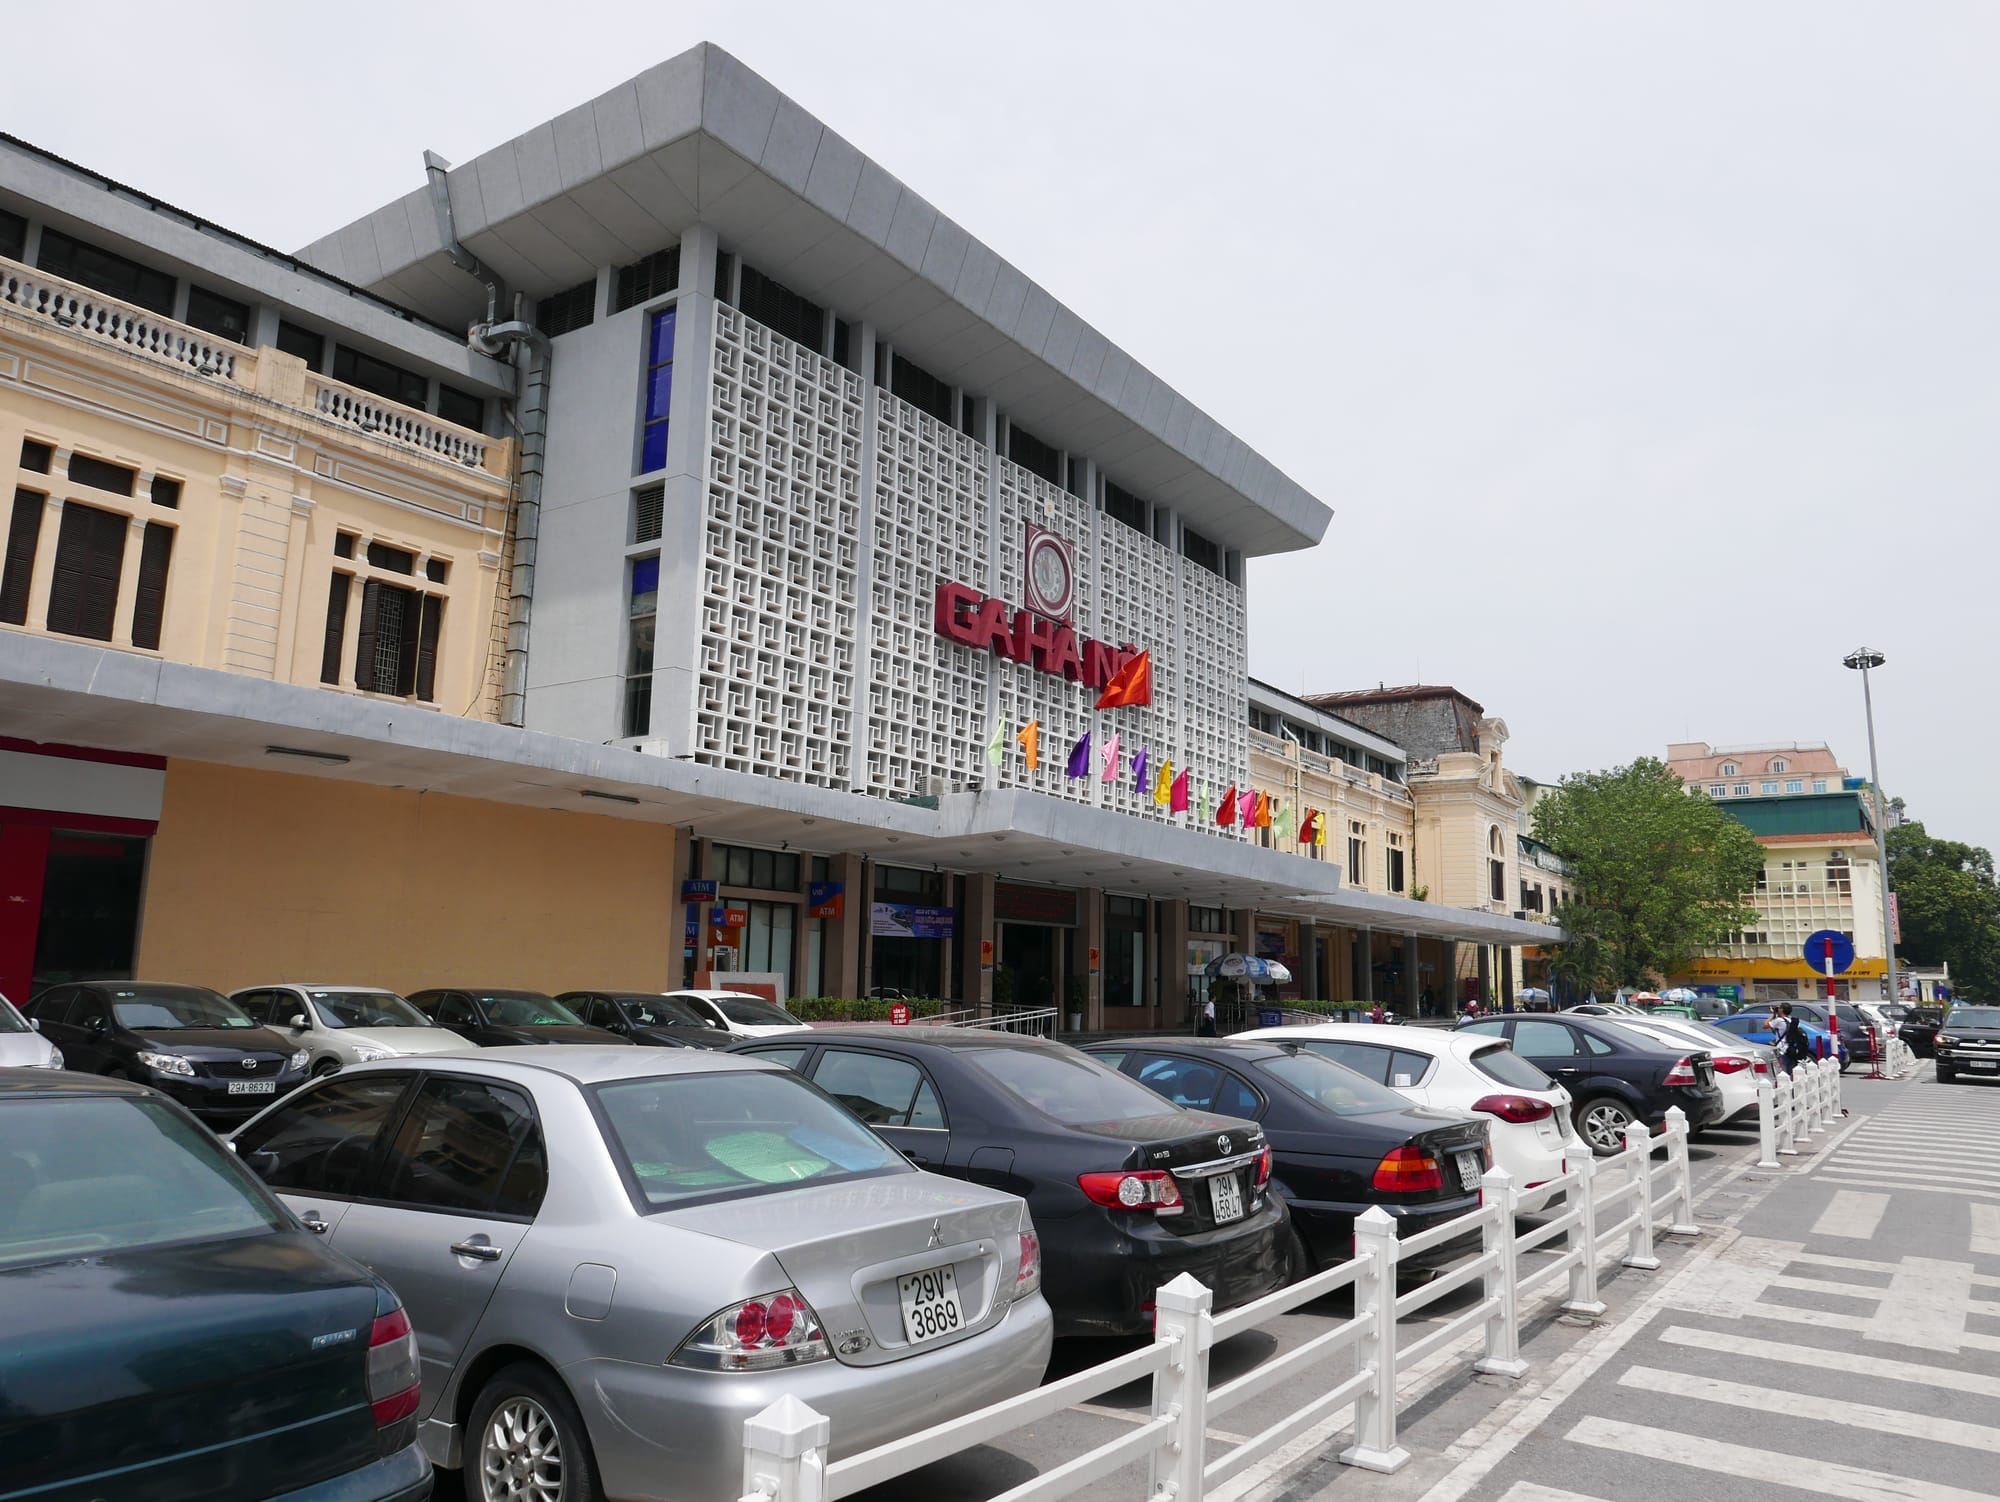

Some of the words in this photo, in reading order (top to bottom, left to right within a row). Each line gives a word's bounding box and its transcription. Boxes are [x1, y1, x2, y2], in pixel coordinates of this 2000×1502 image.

[935, 582, 1015, 657] GA
[1013, 610, 1084, 683] HÀ
[691, 882, 710, 892] ATM
[729, 914, 744, 923] ATM
[819, 907, 836, 917] ATM
[1216, 1175, 1234, 1197] 29A
[1215, 1195, 1241, 1221] 458.47
[910, 1269, 946, 1307] 29V
[911, 1299, 959, 1339] 3869
